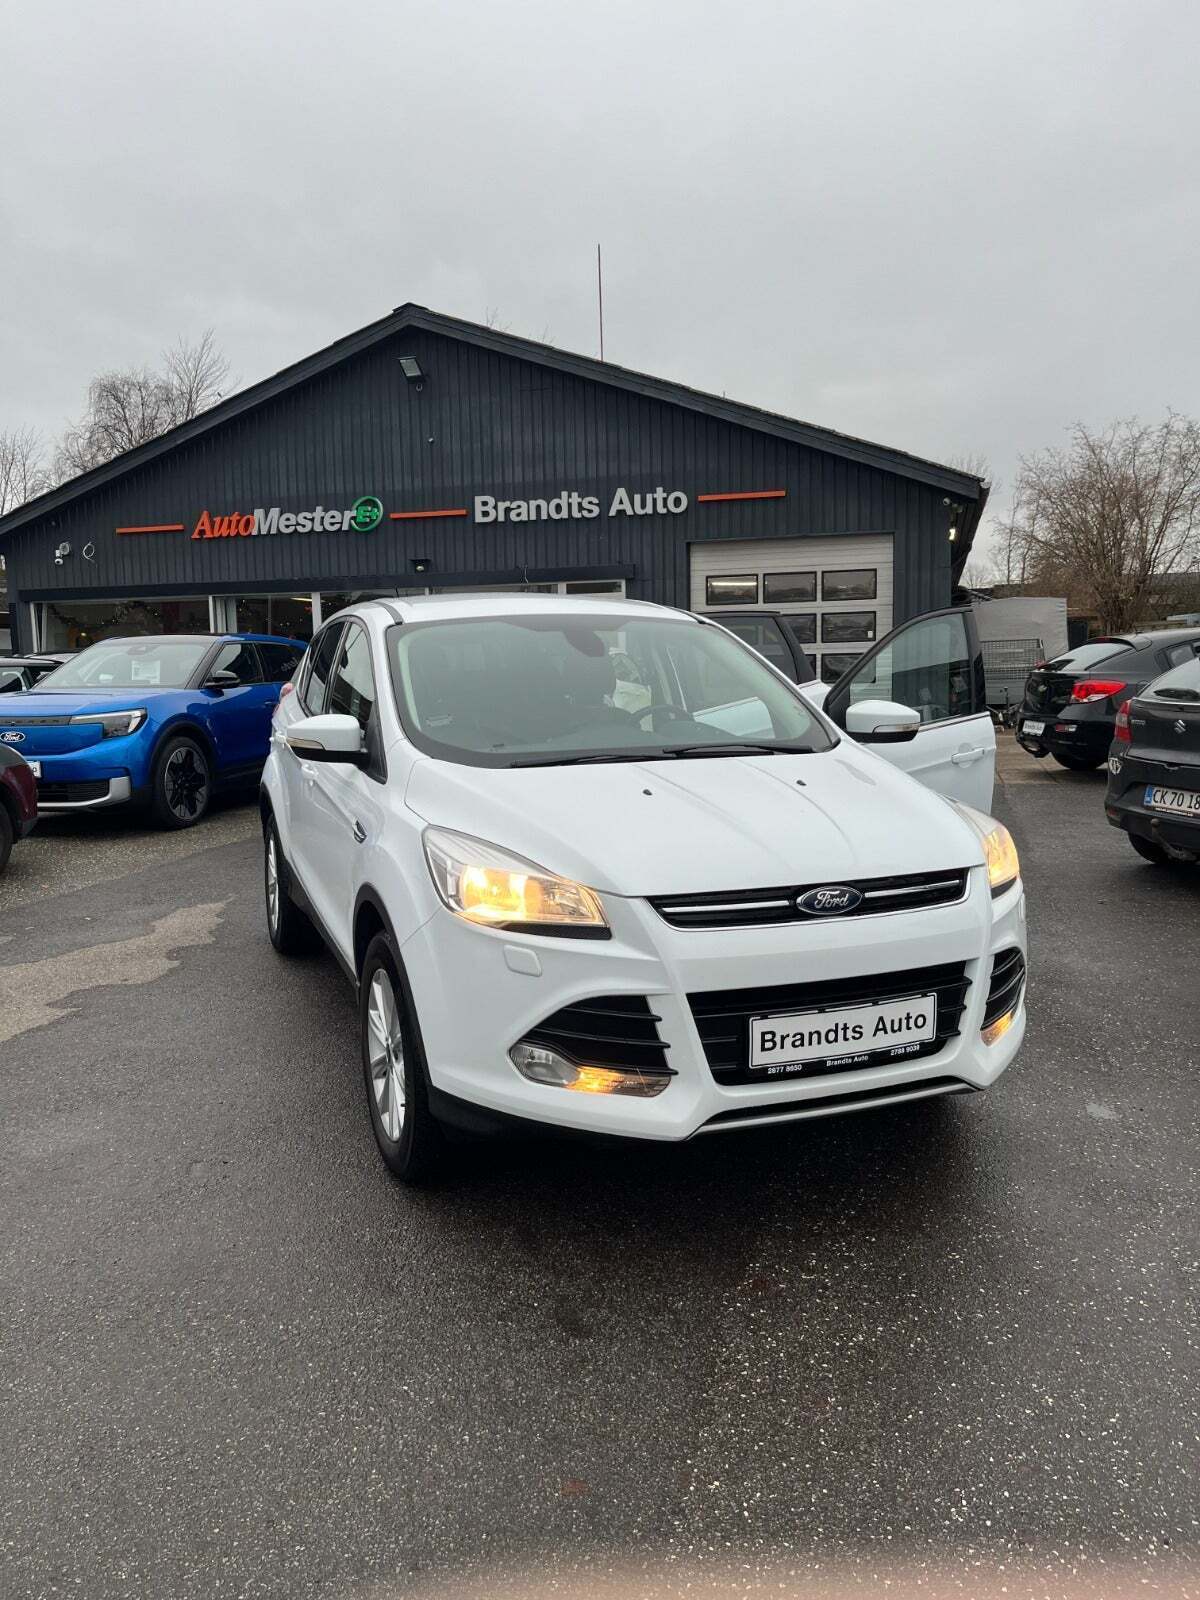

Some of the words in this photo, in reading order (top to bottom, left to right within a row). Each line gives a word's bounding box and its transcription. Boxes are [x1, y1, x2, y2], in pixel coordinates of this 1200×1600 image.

[474, 491, 600, 523] Brandts
[608, 487, 688, 517] Auto
[191, 506, 353, 539] AutoMester
[1153, 789, 1168, 805] CK
[1170, 791, 1185, 807] 70
[814, 890, 849, 909] Ford
[760, 1022, 864, 1052] Brandts
[872, 1012, 927, 1037] Auto
[826, 1056, 852, 1067] Brandts
[853, 1055, 869, 1064] Auto
